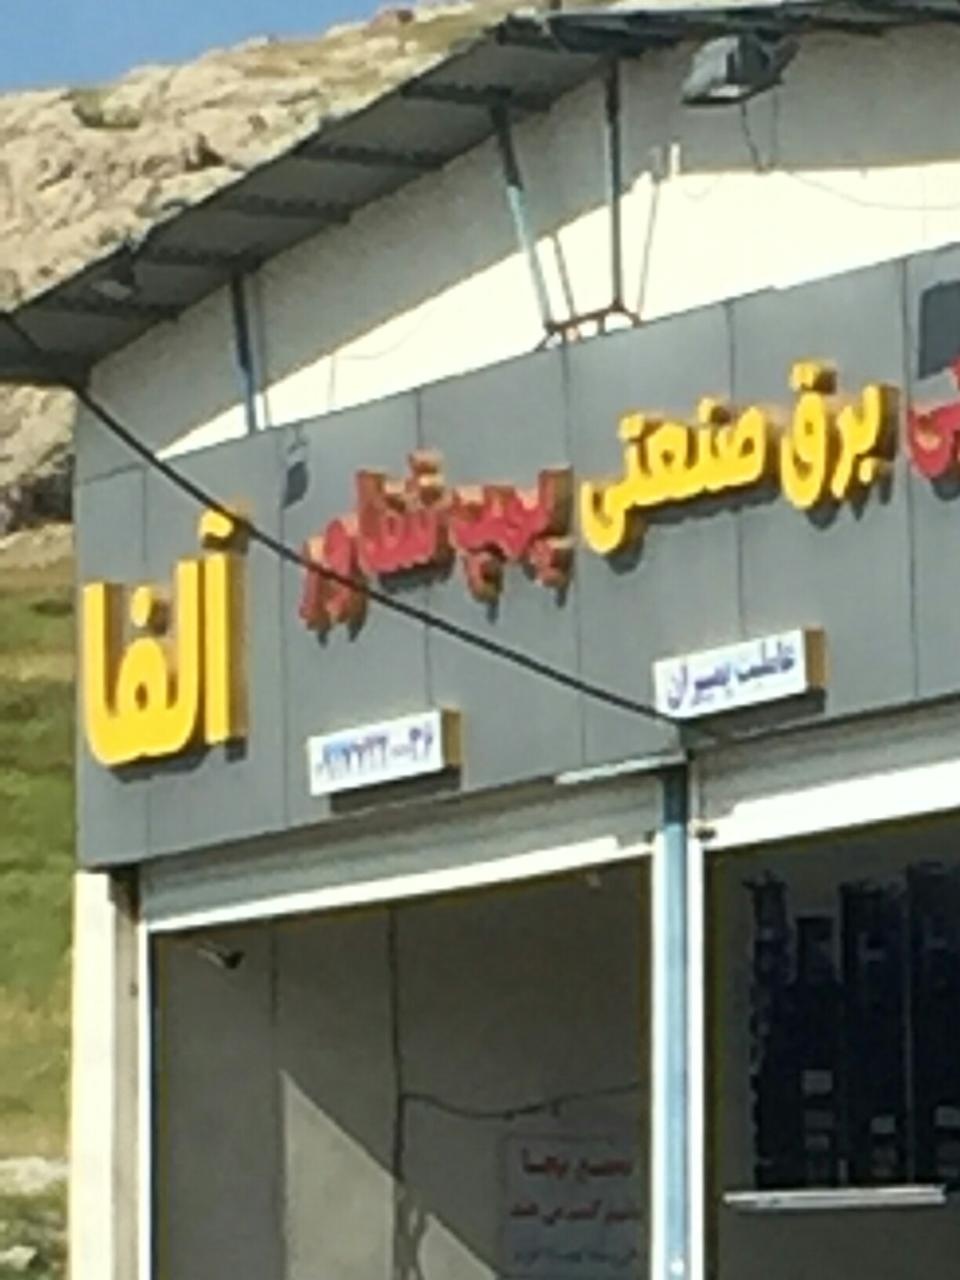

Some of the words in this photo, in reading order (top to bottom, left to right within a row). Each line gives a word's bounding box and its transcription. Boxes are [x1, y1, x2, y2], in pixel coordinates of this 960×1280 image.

[580, 398, 768, 555] صنعتی
[781, 362, 886, 511] برق
[450, 464, 568, 606] پمپ
[83, 508, 236, 766] آلفا
